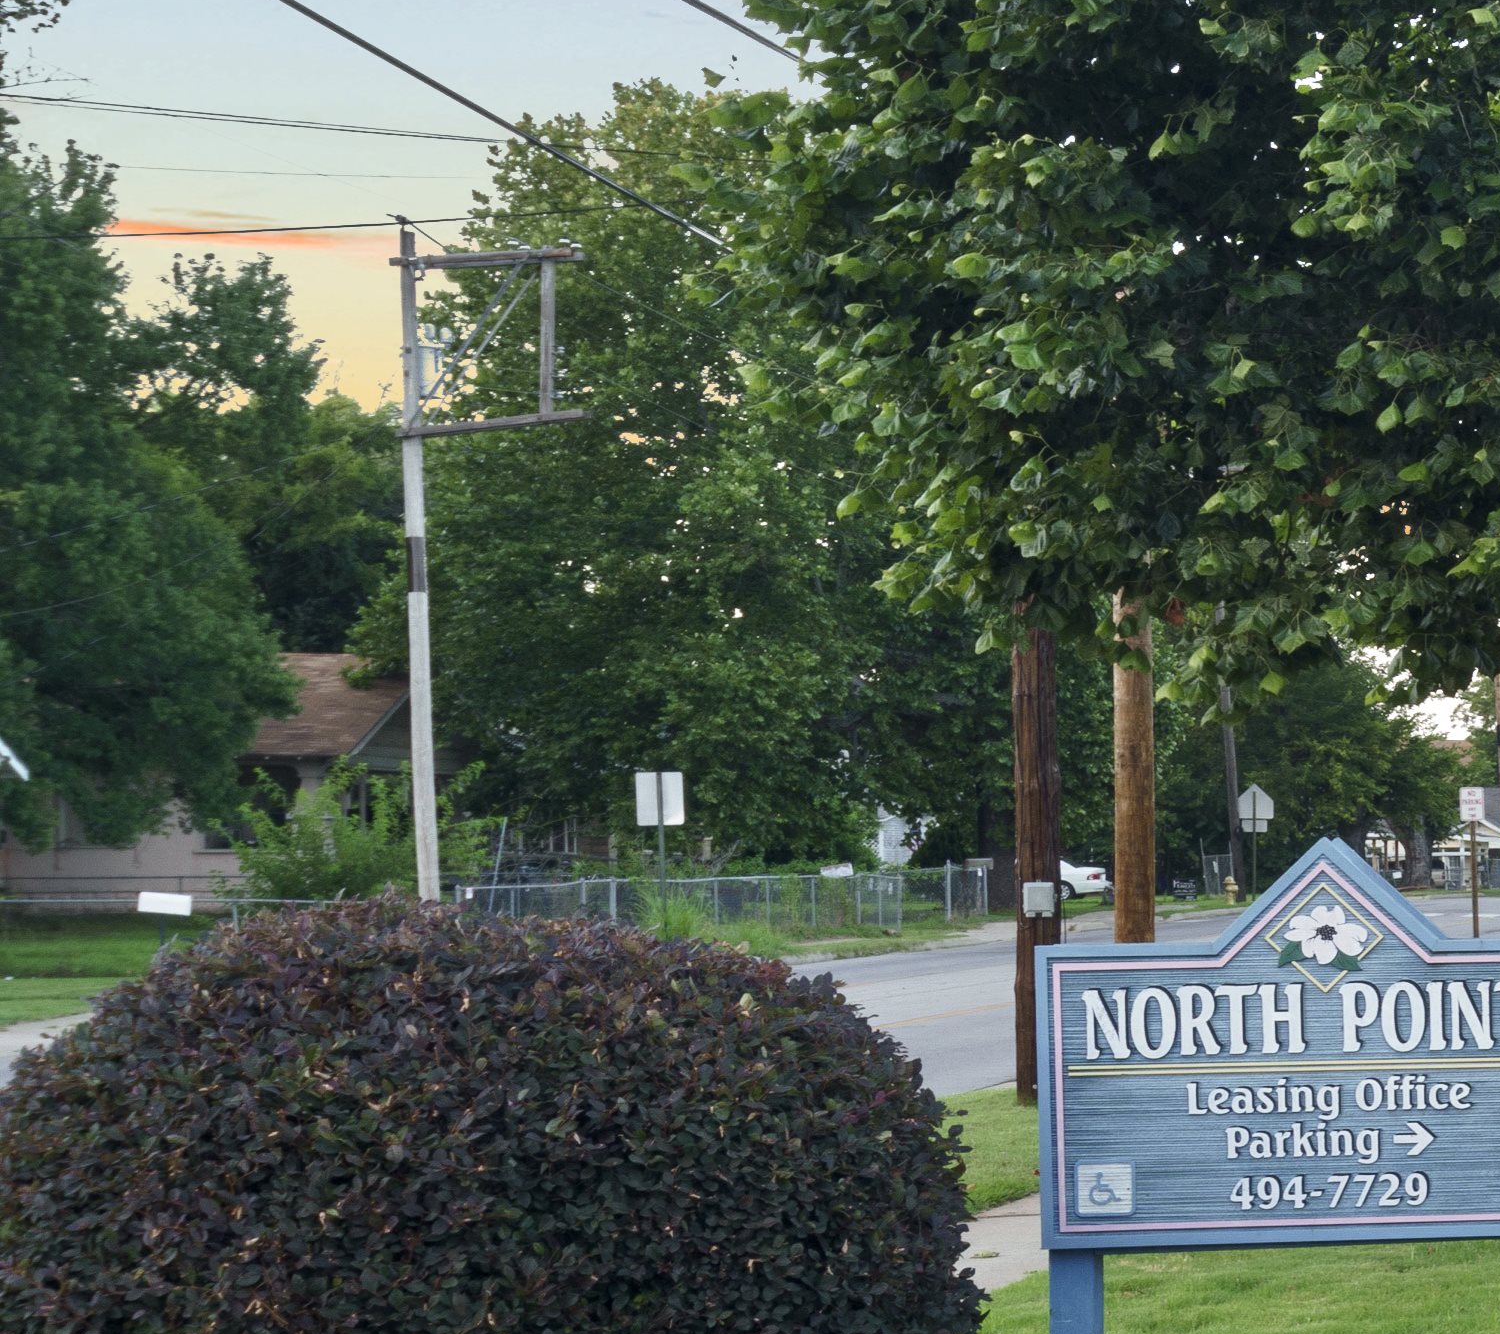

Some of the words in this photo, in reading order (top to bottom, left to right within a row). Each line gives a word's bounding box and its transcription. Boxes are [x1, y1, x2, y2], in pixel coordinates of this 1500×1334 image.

[1081, 983, 1307, 1060] NORTH
[1186, 1077, 1342, 1121] Leasing
[1355, 1075, 1473, 1112] Office
[1224, 1122, 1381, 1165] Parking
[1229, 1172, 1430, 1211] 494-7729
